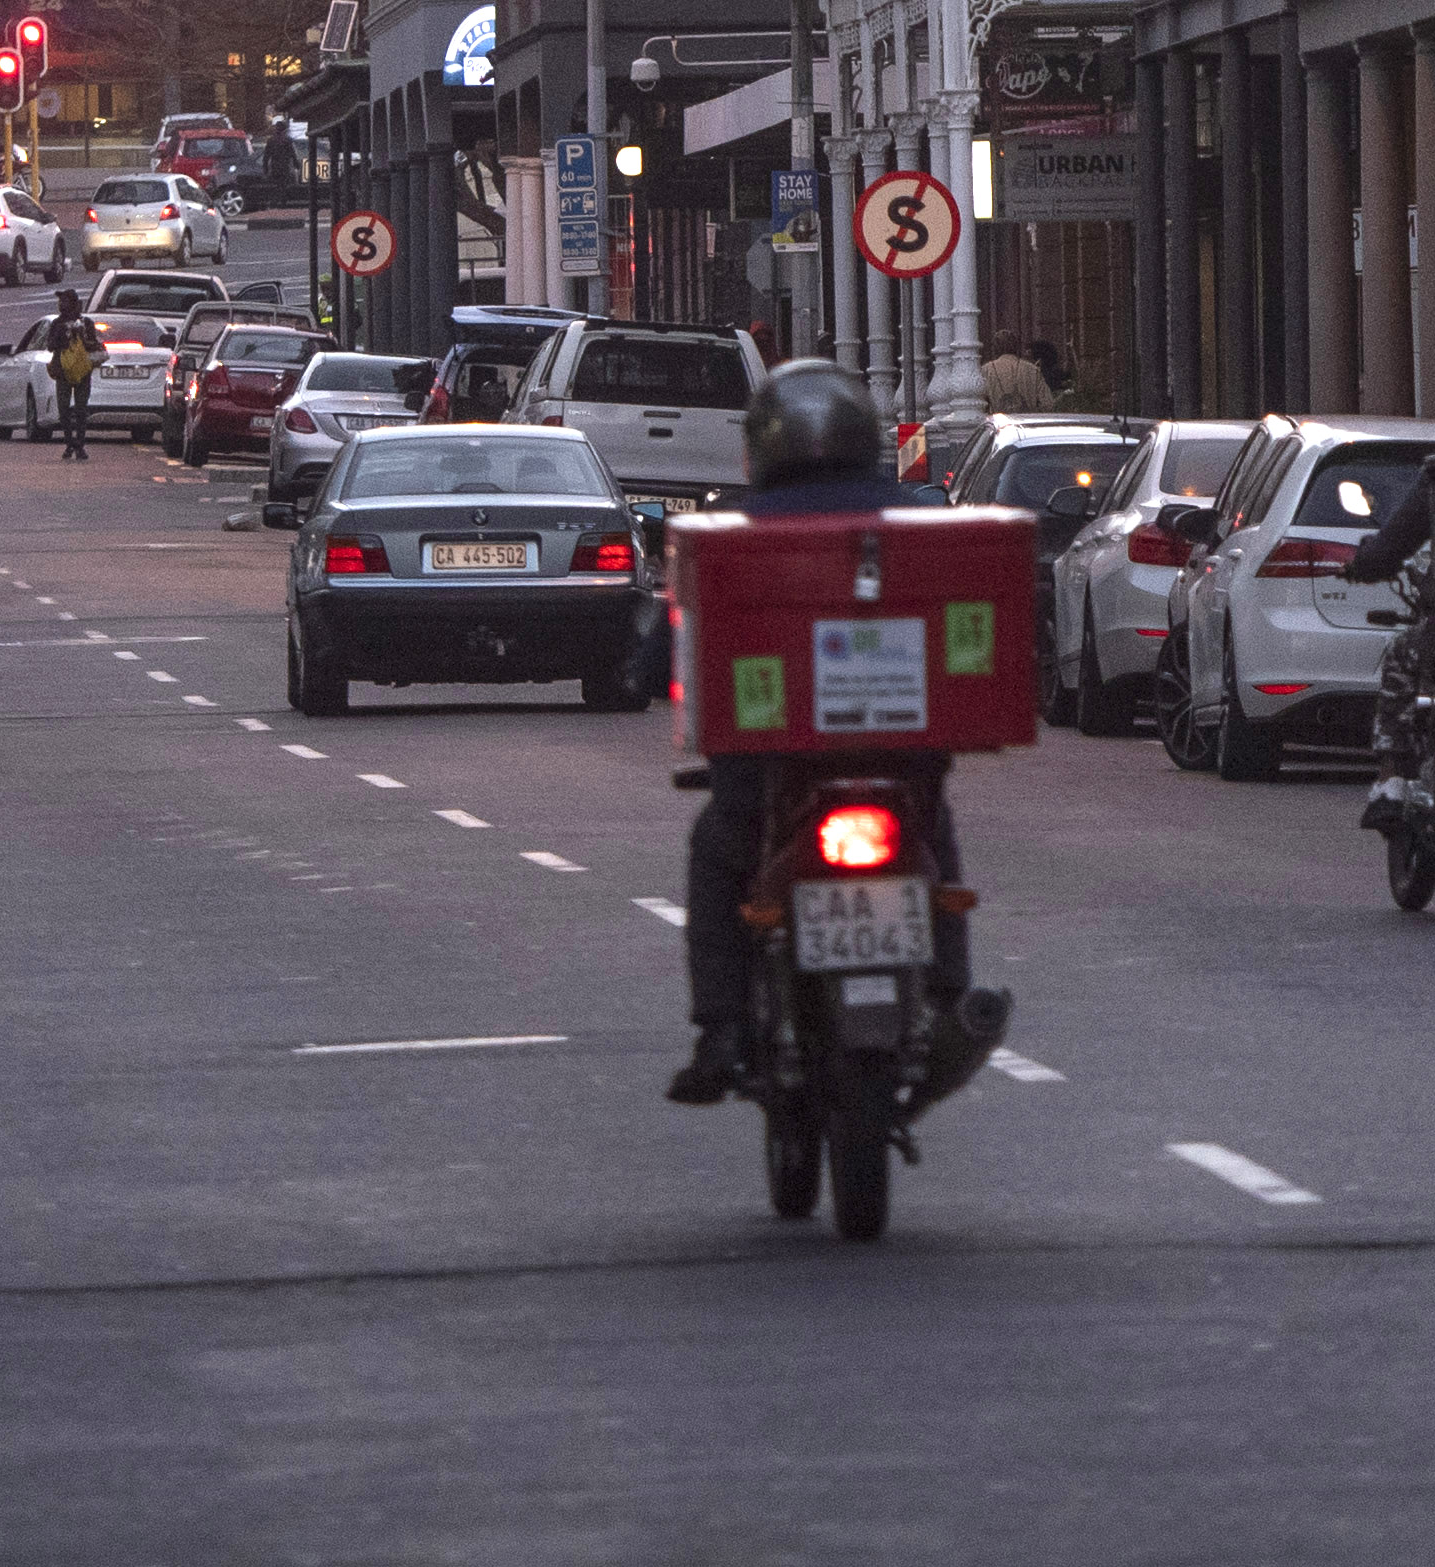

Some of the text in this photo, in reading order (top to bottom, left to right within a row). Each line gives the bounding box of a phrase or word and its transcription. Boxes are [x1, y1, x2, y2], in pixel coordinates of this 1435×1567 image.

[566, 143, 585, 166] P
[1037, 155, 1125, 175] URBAN
[561, 171, 575, 182] 60
[778, 175, 813, 189] STAY
[778, 188, 814, 200] HOME
[435, 543, 526, 565] CA 445-502
